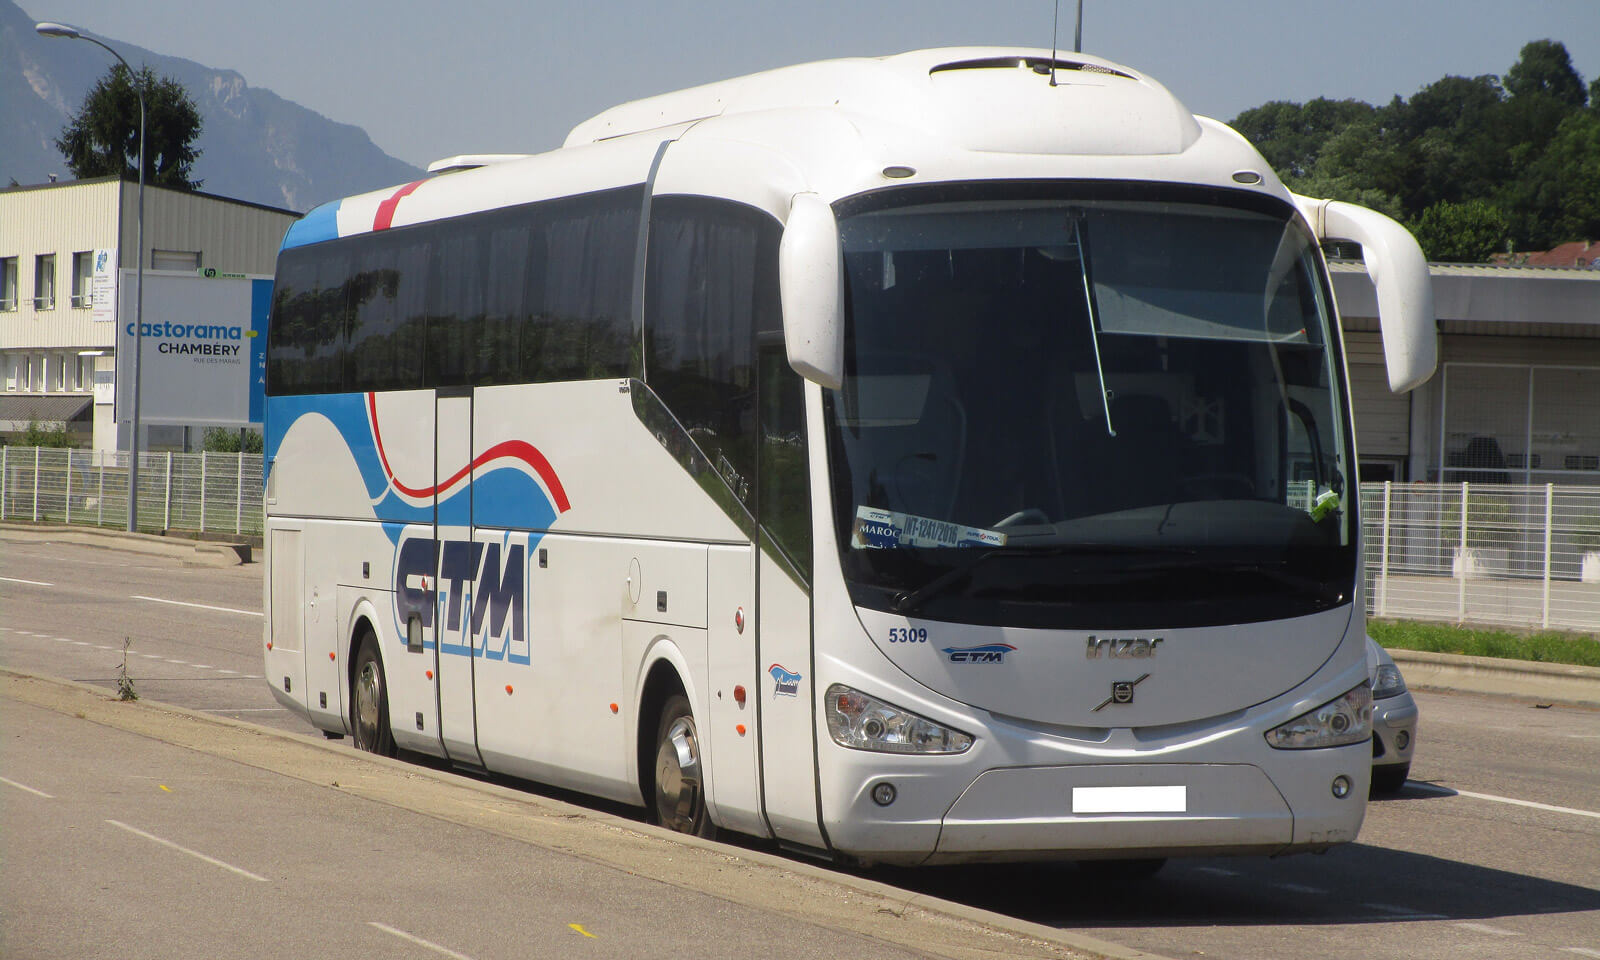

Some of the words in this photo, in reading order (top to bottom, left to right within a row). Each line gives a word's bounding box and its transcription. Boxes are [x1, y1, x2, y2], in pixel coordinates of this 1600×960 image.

[158, 342, 241, 356] CHAMBÉRY
[396, 538, 525, 642] CTM
[888, 628, 928, 643] 5309
[950, 651, 1003, 664] CTM
